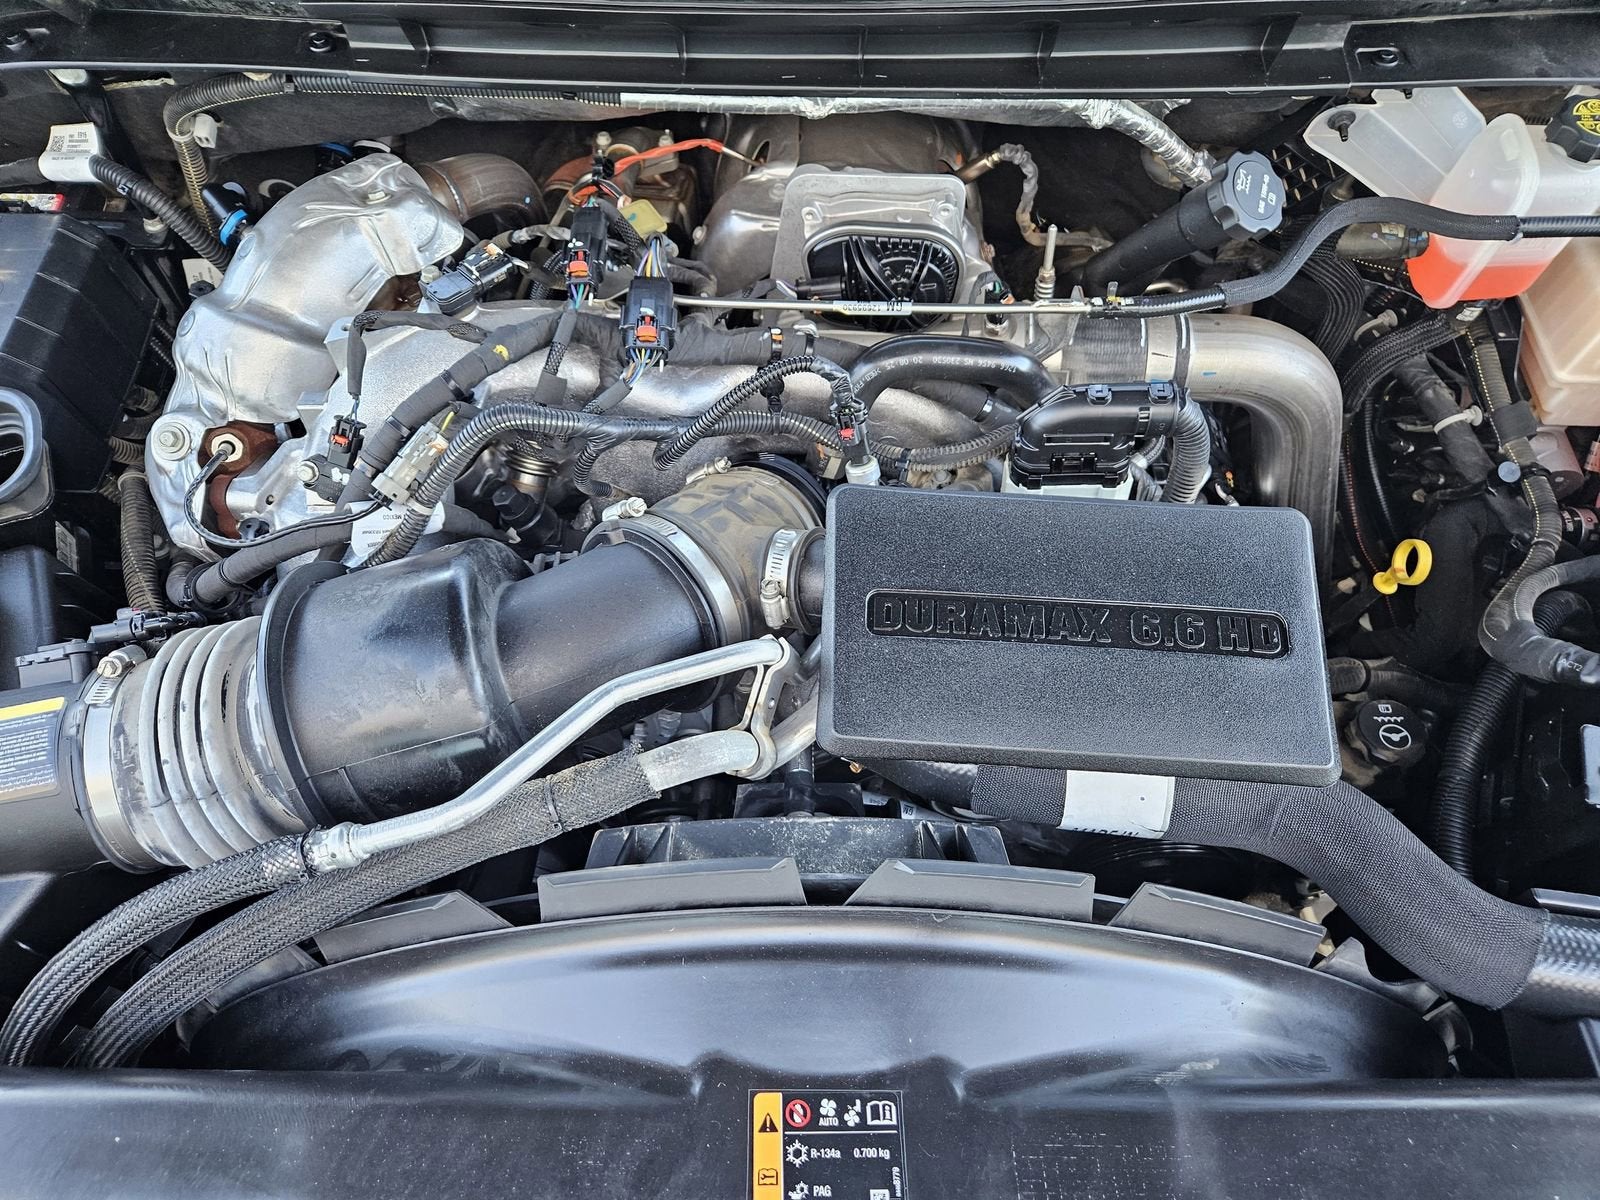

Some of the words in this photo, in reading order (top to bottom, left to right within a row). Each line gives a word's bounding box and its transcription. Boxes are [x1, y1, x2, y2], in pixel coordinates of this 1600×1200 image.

[886, 301, 903, 312] GM
[871, 599, 1112, 643] DURAMAX
[1130, 610, 1207, 649] 6.6
[1219, 615, 1282, 654] HD
[902, 807, 913, 816] GM
[818, 1117, 839, 1127] AUTO
[810, 1148, 842, 1159] R-134a
[853, 1147, 877, 1159] 0.700
[878, 1147, 890, 1160] kg
[813, 1185, 832, 1198] PAG
